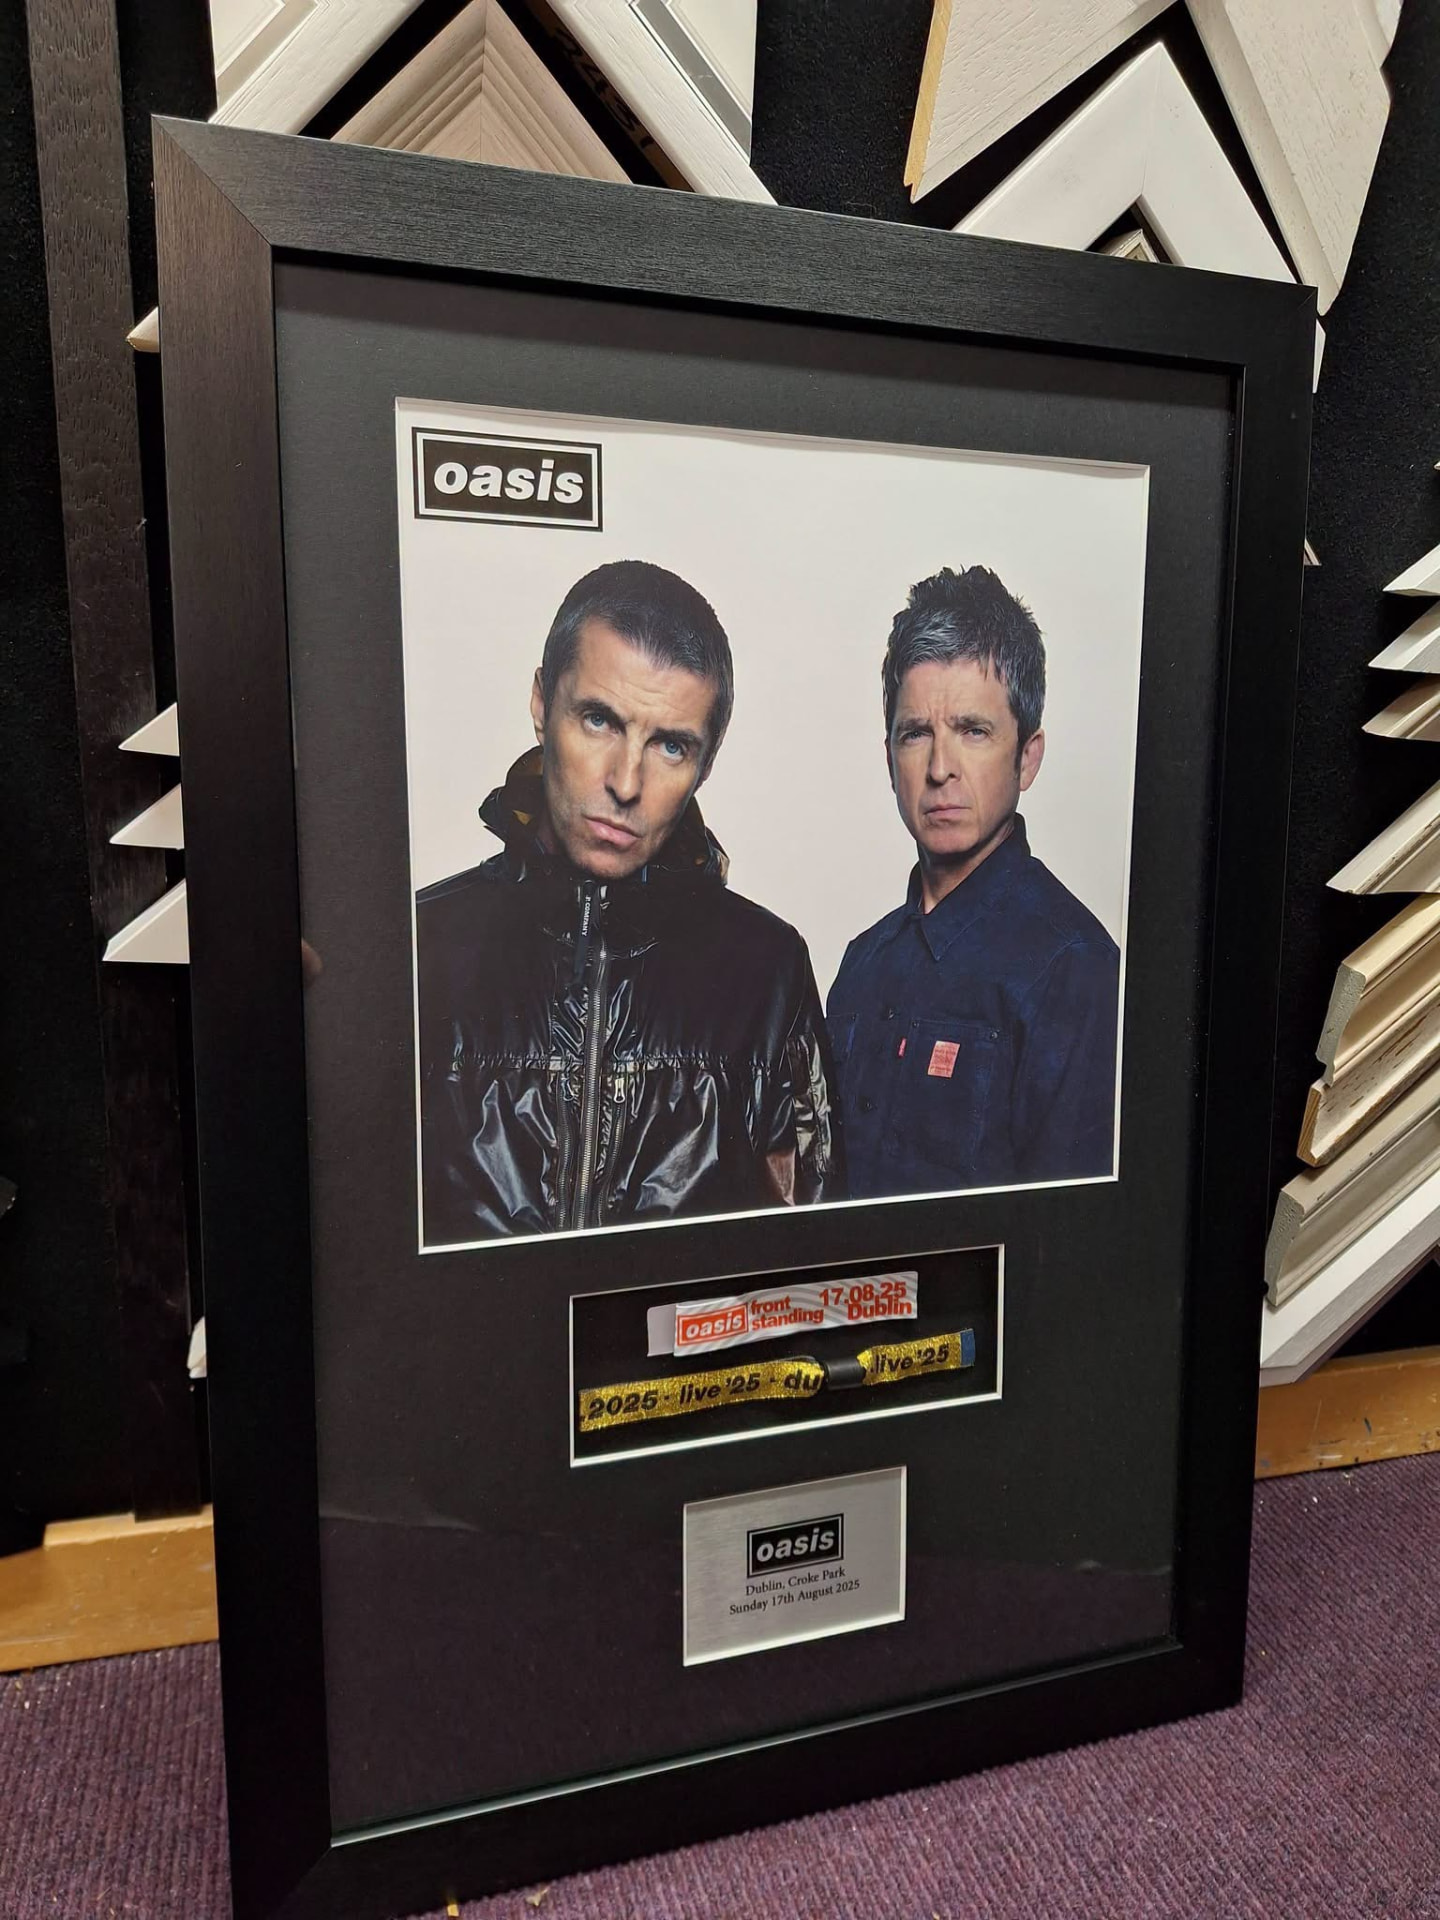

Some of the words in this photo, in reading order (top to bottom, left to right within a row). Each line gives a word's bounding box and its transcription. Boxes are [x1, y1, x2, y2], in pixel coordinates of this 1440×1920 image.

[433, 458, 584, 504] oasis
[750, 1295, 791, 1315] front
[818, 1281, 908, 1307] 17.08.25
[847, 1294, 913, 1321] Dublin
[685, 1311, 744, 1339] oasis
[751, 1308, 824, 1331] standing
[679, 1382, 721, 1406] live
[755, 1526, 836, 1563] oasis
[745, 1579, 785, 1597] Dublin,
[787, 1571, 820, 1588] Croke
[822, 1565, 847, 1581] Park
[729, 1599, 769, 1616] Sunday
[771, 1592, 795, 1607] 17th
[797, 1585, 833, 1602] August
[835, 1578, 861, 1594] 2025
